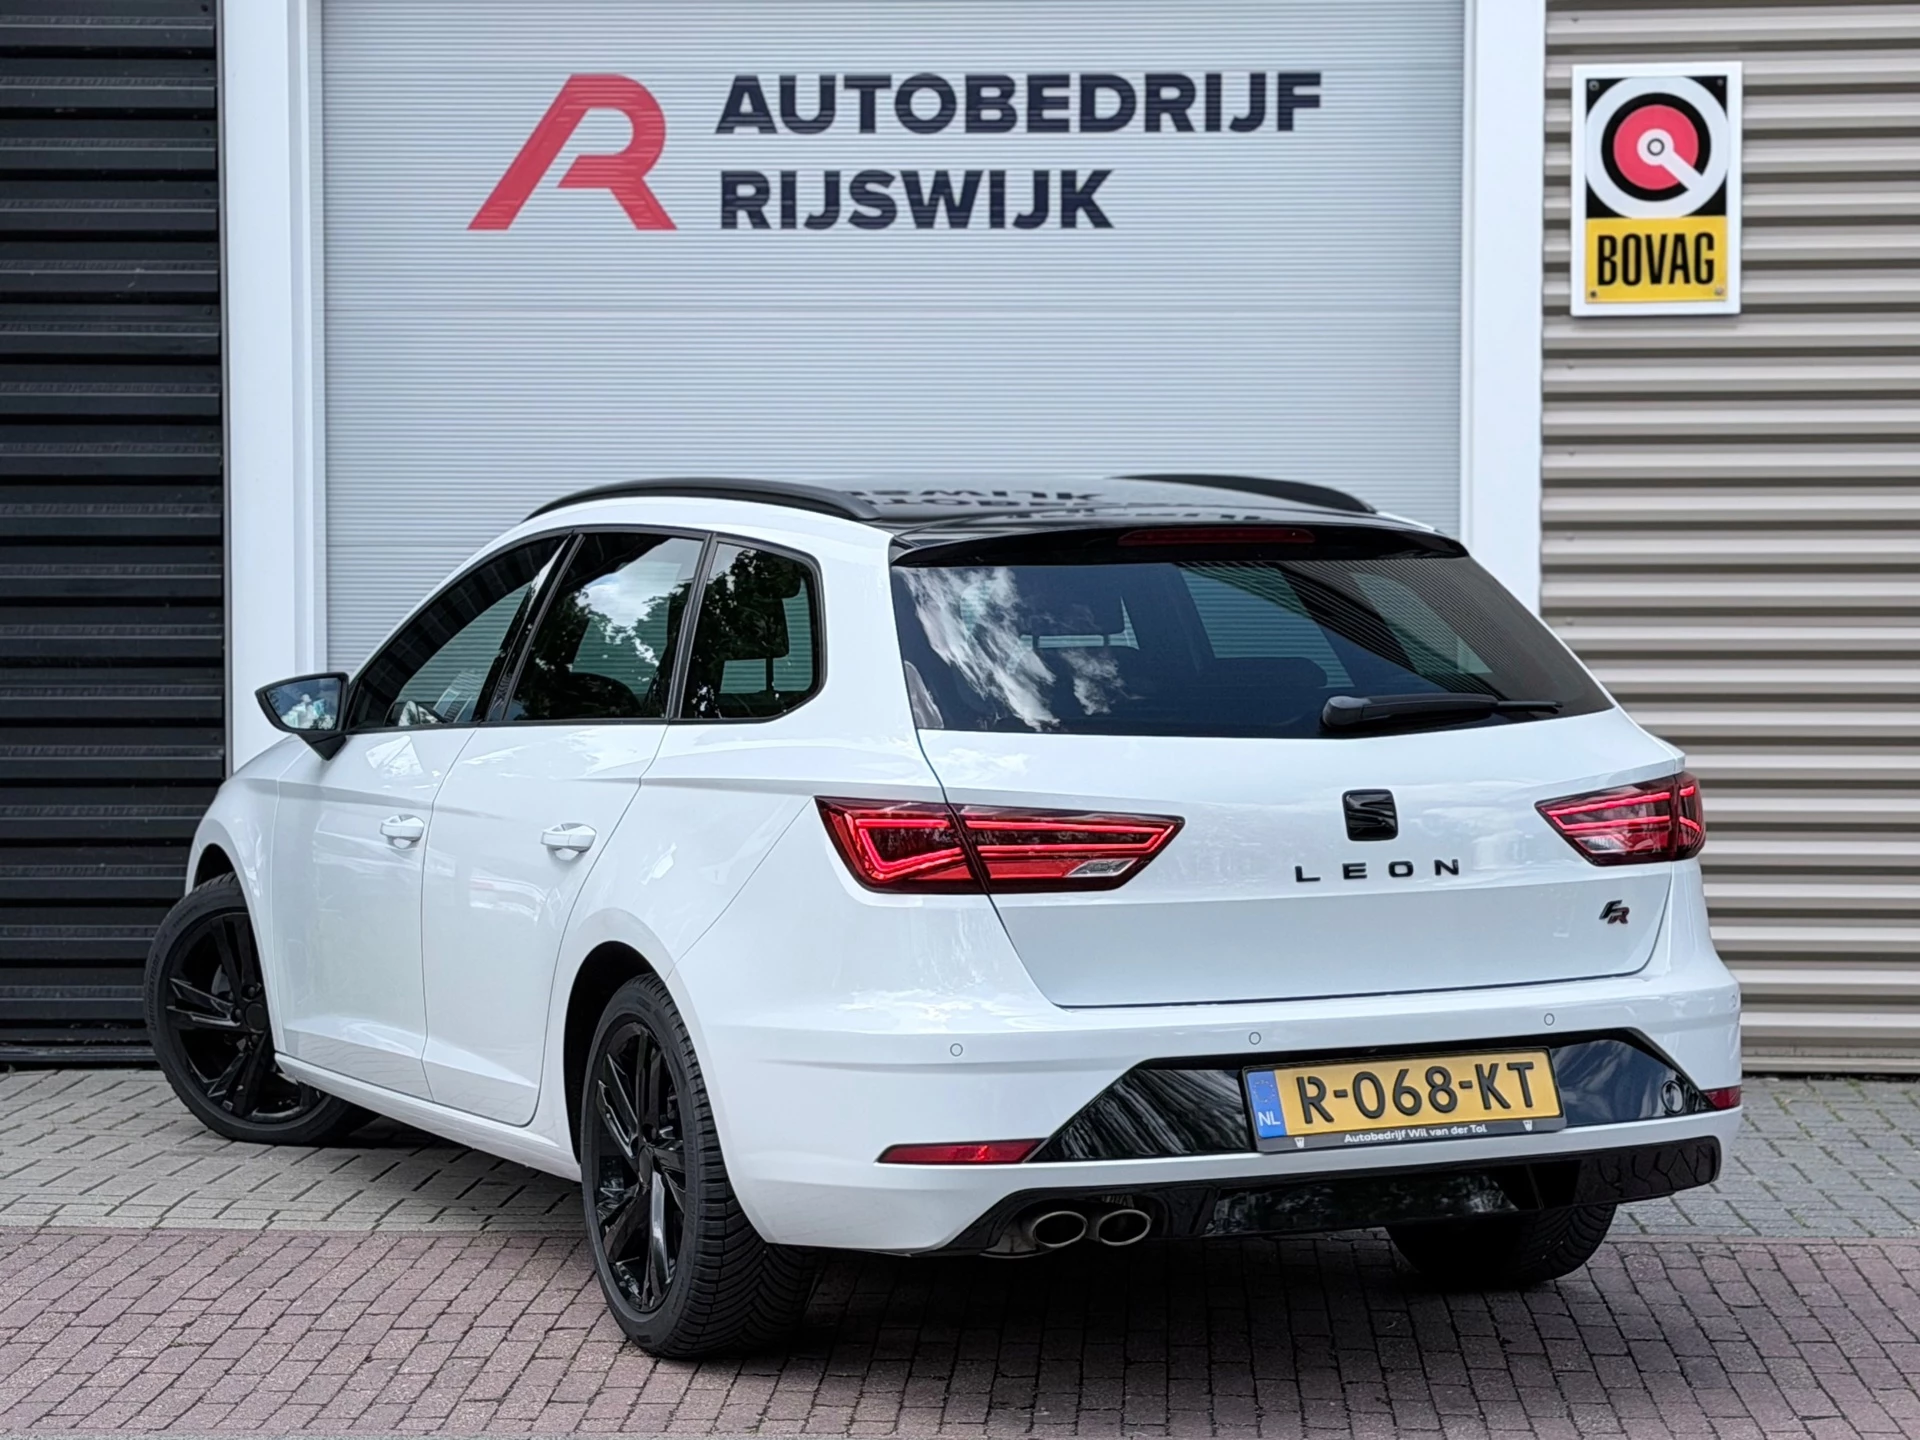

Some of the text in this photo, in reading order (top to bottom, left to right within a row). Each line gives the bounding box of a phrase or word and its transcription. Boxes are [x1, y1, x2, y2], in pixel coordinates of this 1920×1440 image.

[715, 71, 1322, 135] AUTOBEDRIJF
[720, 169, 1114, 229] RIJSWIJK
[1597, 232, 1715, 287] BOVAG
[1294, 858, 1461, 883] LEON
[1257, 1110, 1281, 1127] NL
[1295, 1061, 1535, 1125] R-068-KT
[1344, 1123, 1488, 1143] Autobedrijf Wil van der Tol
